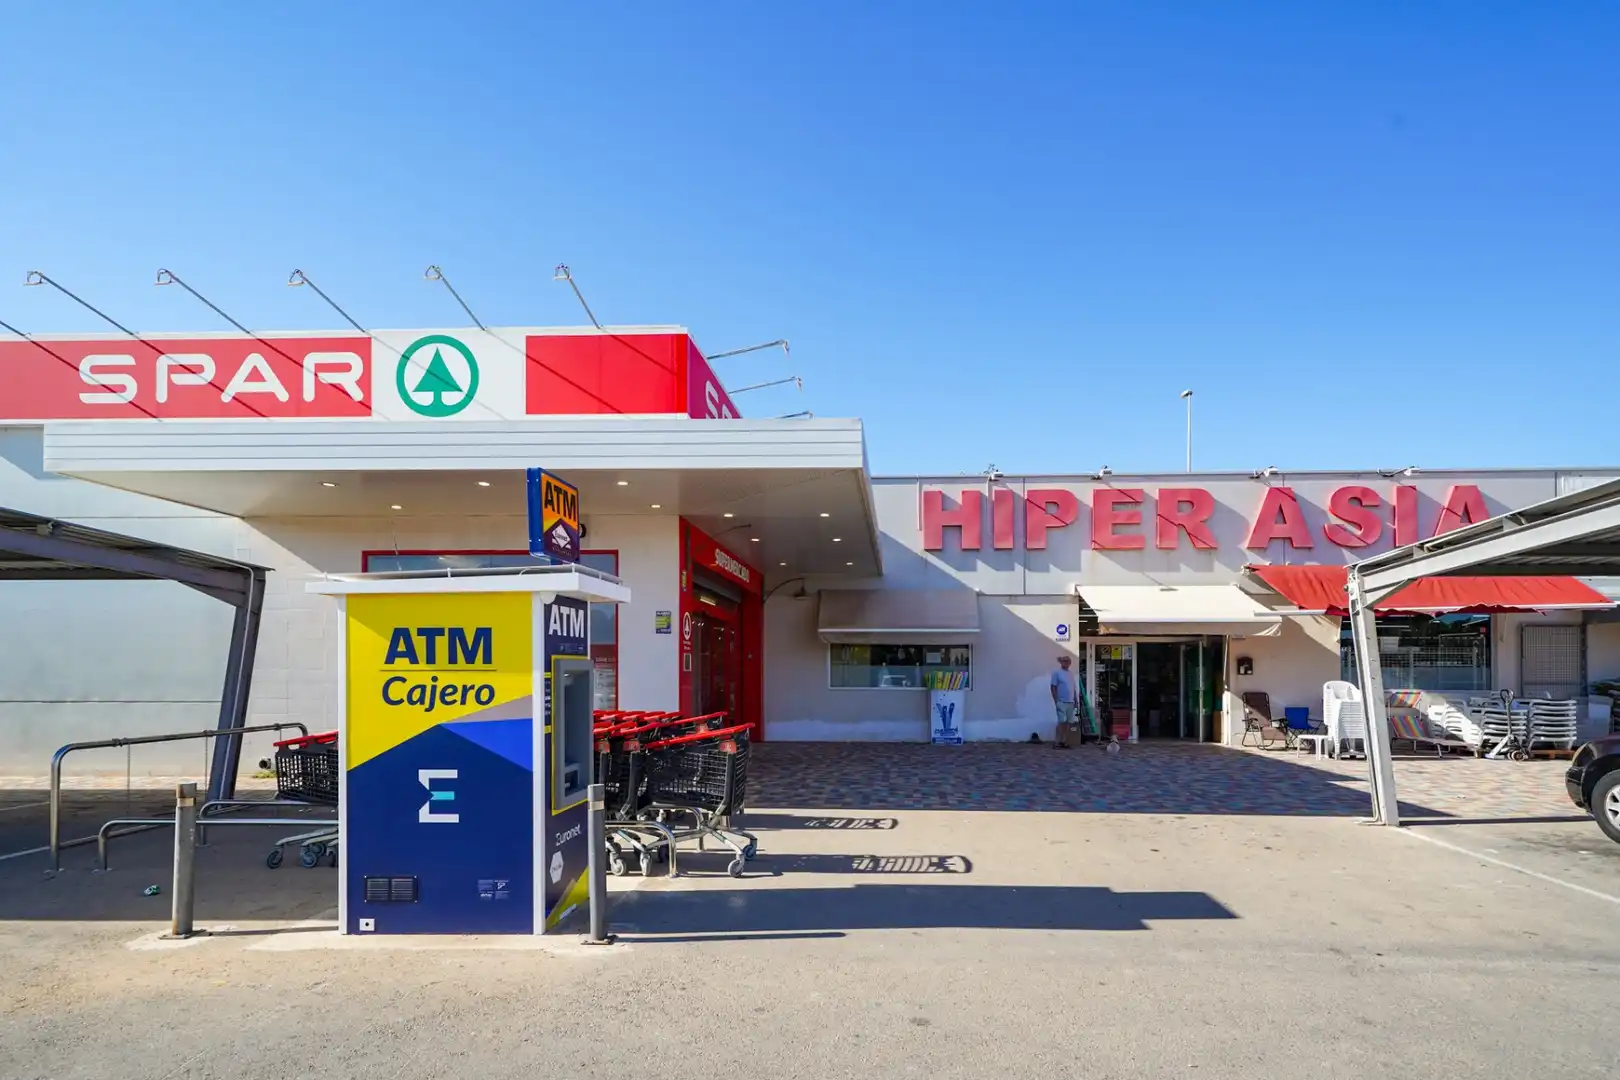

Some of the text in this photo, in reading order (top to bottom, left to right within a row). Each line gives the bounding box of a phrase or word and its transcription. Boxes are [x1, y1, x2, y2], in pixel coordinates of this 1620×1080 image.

[79, 352, 364, 404] SPAR
[544, 480, 577, 522] ATM
[923, 485, 1493, 550] HIPER ASIA
[548, 604, 585, 639] ATM
[384, 627, 493, 665] ATM
[382, 675, 496, 713] Cajero
[555, 823, 581, 847] Euronet
